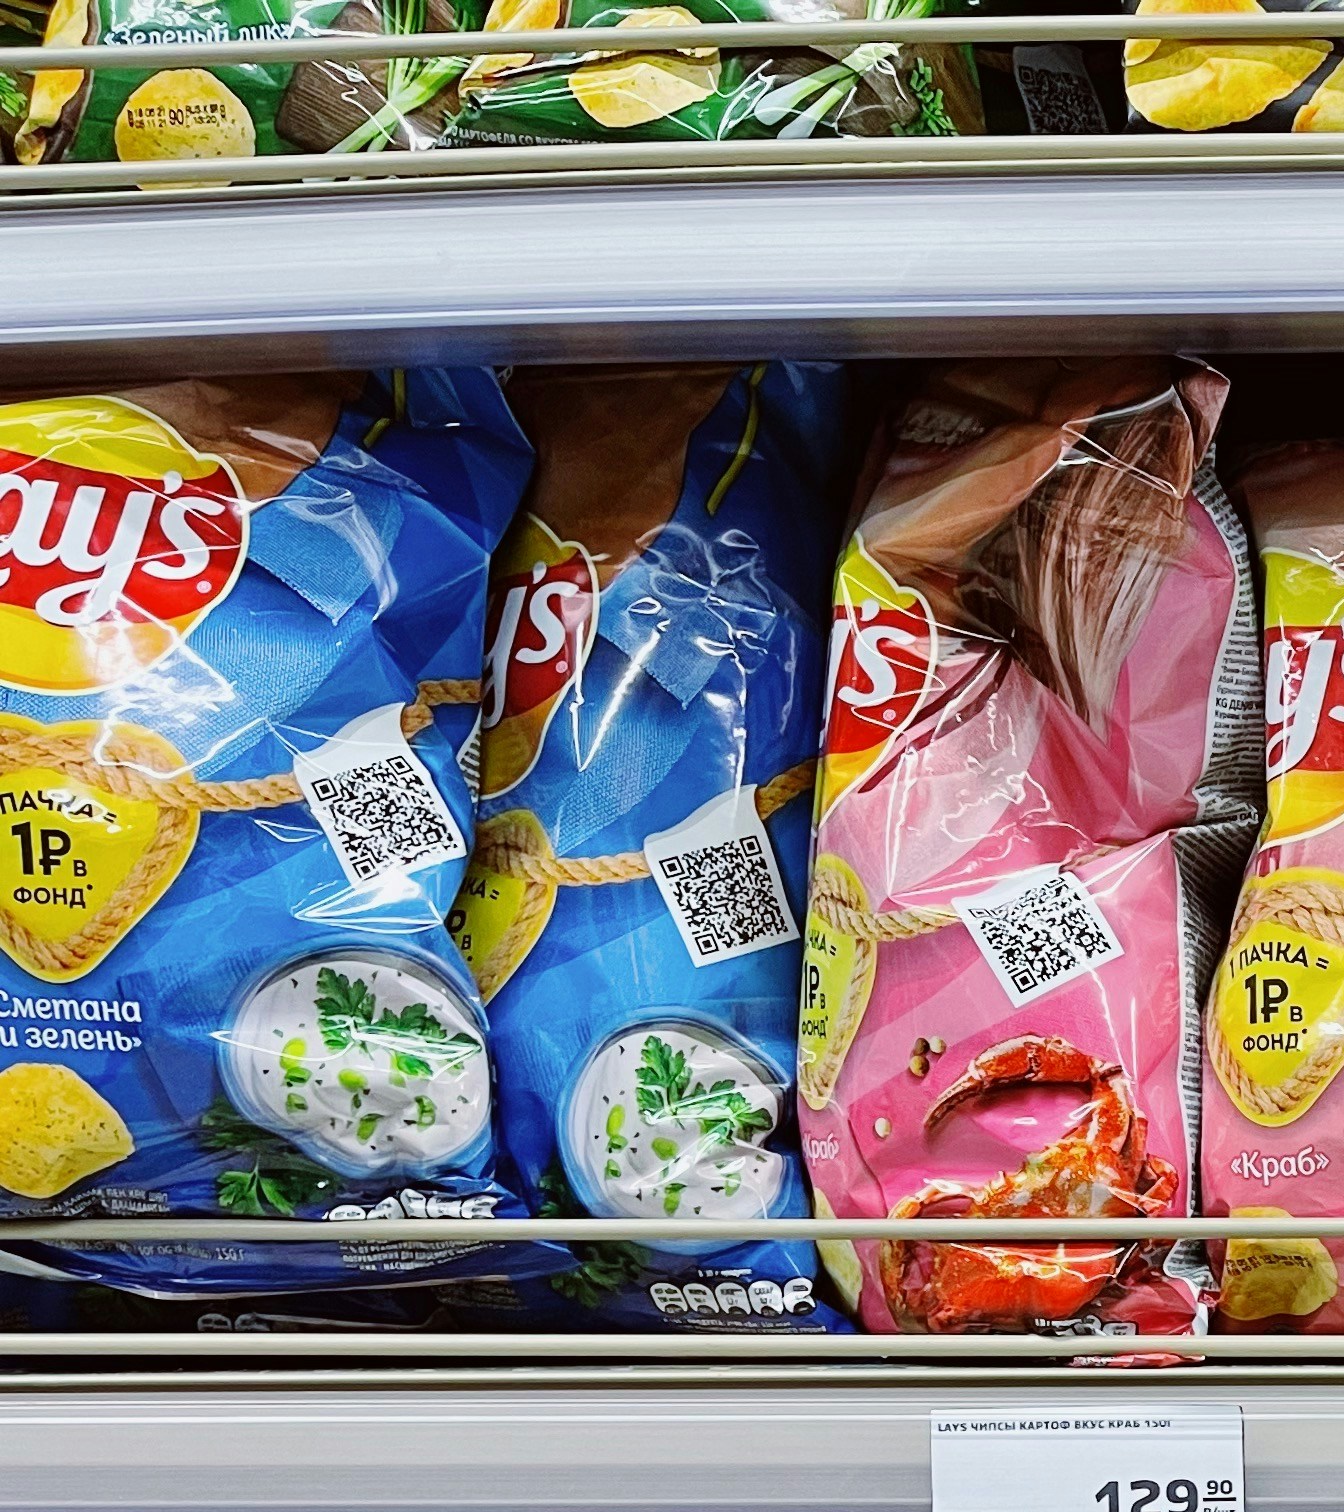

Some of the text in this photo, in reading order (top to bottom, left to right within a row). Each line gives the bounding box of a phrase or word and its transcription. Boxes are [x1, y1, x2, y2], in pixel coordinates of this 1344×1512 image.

[0, 469, 227, 628] ay's
[1238, 940, 1310, 970] ПАЧКА
[25, 1026, 143, 1052] зелень»
[1230, 1146, 1331, 1186] «Краб»
[937, 1422, 968, 1432] LAYS
[970, 1421, 1016, 1432] ЧИПСЫ
[1019, 1420, 1071, 1431] КАРТОФ
[1074, 1419, 1105, 1430] ВКУС
[1108, 1419, 1141, 1429] КРАБ
[1206, 1479, 1233, 1495] 90
